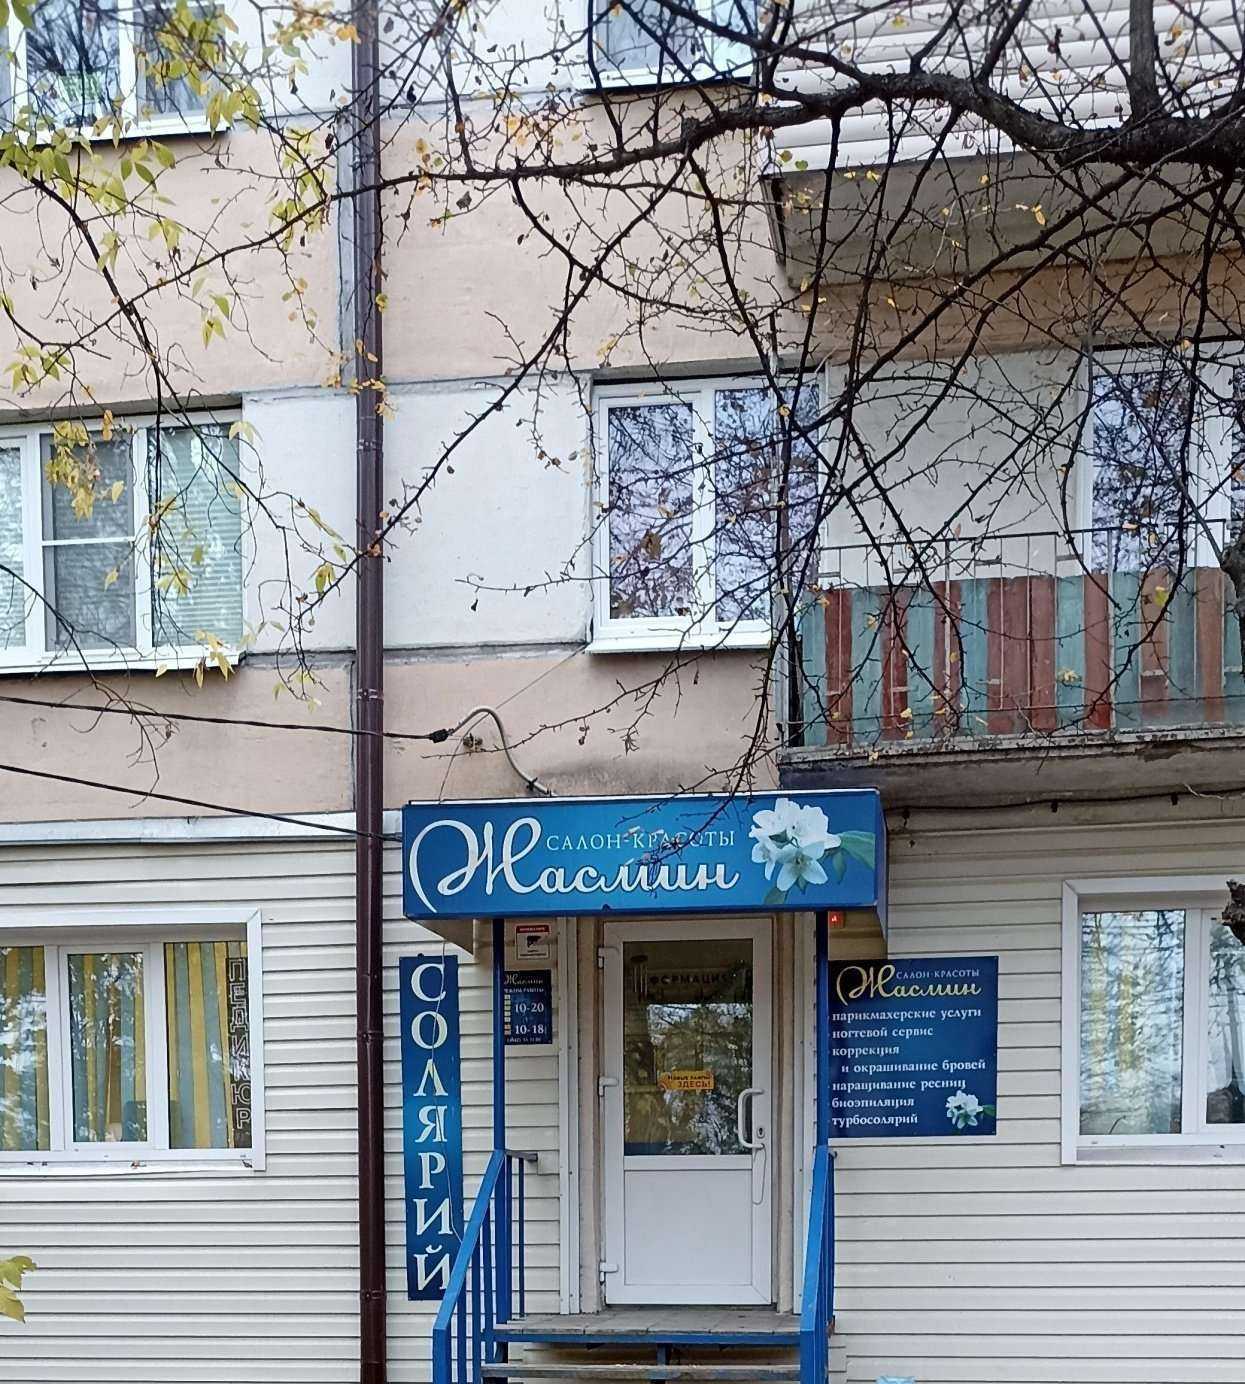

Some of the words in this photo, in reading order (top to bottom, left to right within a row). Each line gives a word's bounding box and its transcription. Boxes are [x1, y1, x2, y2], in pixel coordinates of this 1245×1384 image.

[409, 817, 739, 913] Жасмин
[836, 964, 982, 1006] Жасмин
[515, 1002, 545, 1013] 10-20
[832, 1009, 936, 1022] парикмахерские
[941, 1008, 982, 1020] услуги
[515, 1024, 545, 1035] 10-18
[832, 1027, 888, 1039] ногтевой
[892, 1028, 934, 1039] сервис
[229, 959, 251, 1130] ПЕДИКЮР
[832, 1046, 900, 1058] коррекция
[841, 1065, 849, 1073] и
[853, 1062, 939, 1075] окрашивание
[942, 1059, 986, 1073] бровей
[832, 1081, 917, 1092] наращивание
[920, 1079, 966, 1091] ресниц
[831, 1097, 915, 1108] биоэпиляция
[411, 963, 453, 1292] СОЛЯРИЙ
[832, 1113, 918, 1128] турбосолярий
